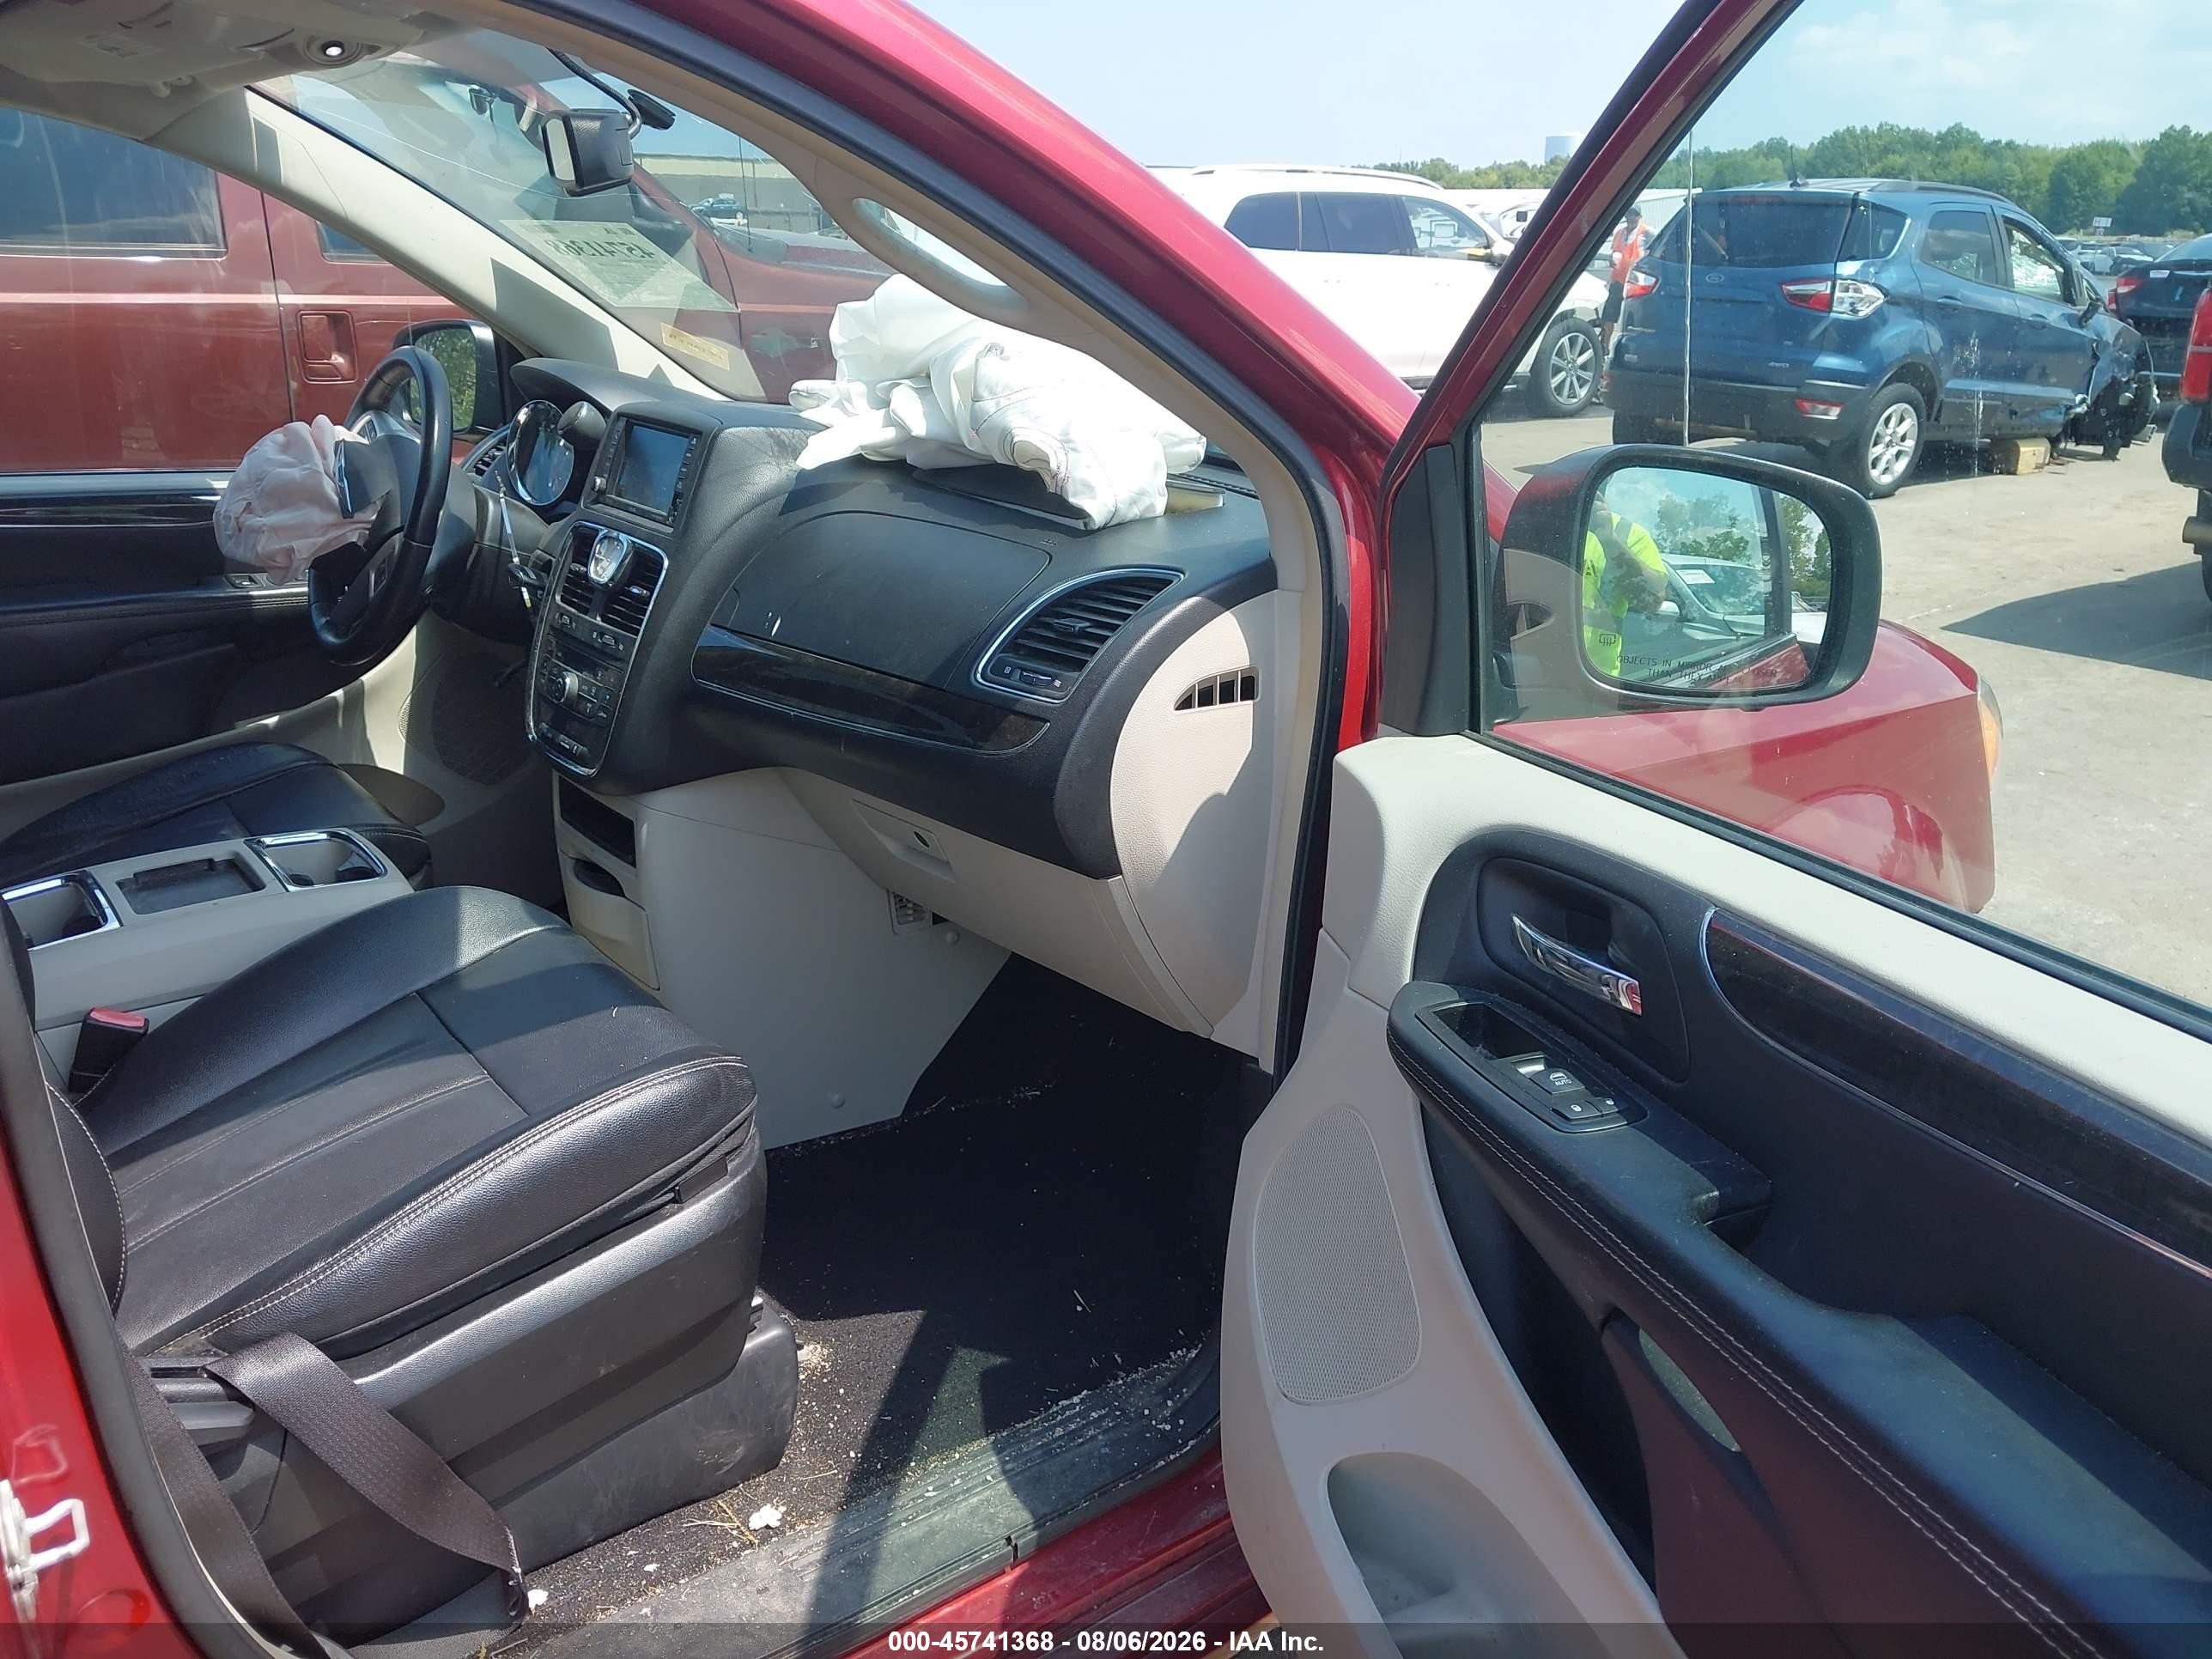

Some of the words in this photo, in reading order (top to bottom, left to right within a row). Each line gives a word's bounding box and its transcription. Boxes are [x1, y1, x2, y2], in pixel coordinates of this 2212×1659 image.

[1616, 654, 1658, 667] OBJECTS
[1662, 658, 1673, 668] IN
[1677, 659, 1713, 672] MIRROR
[1648, 668, 1672, 678] THAN
